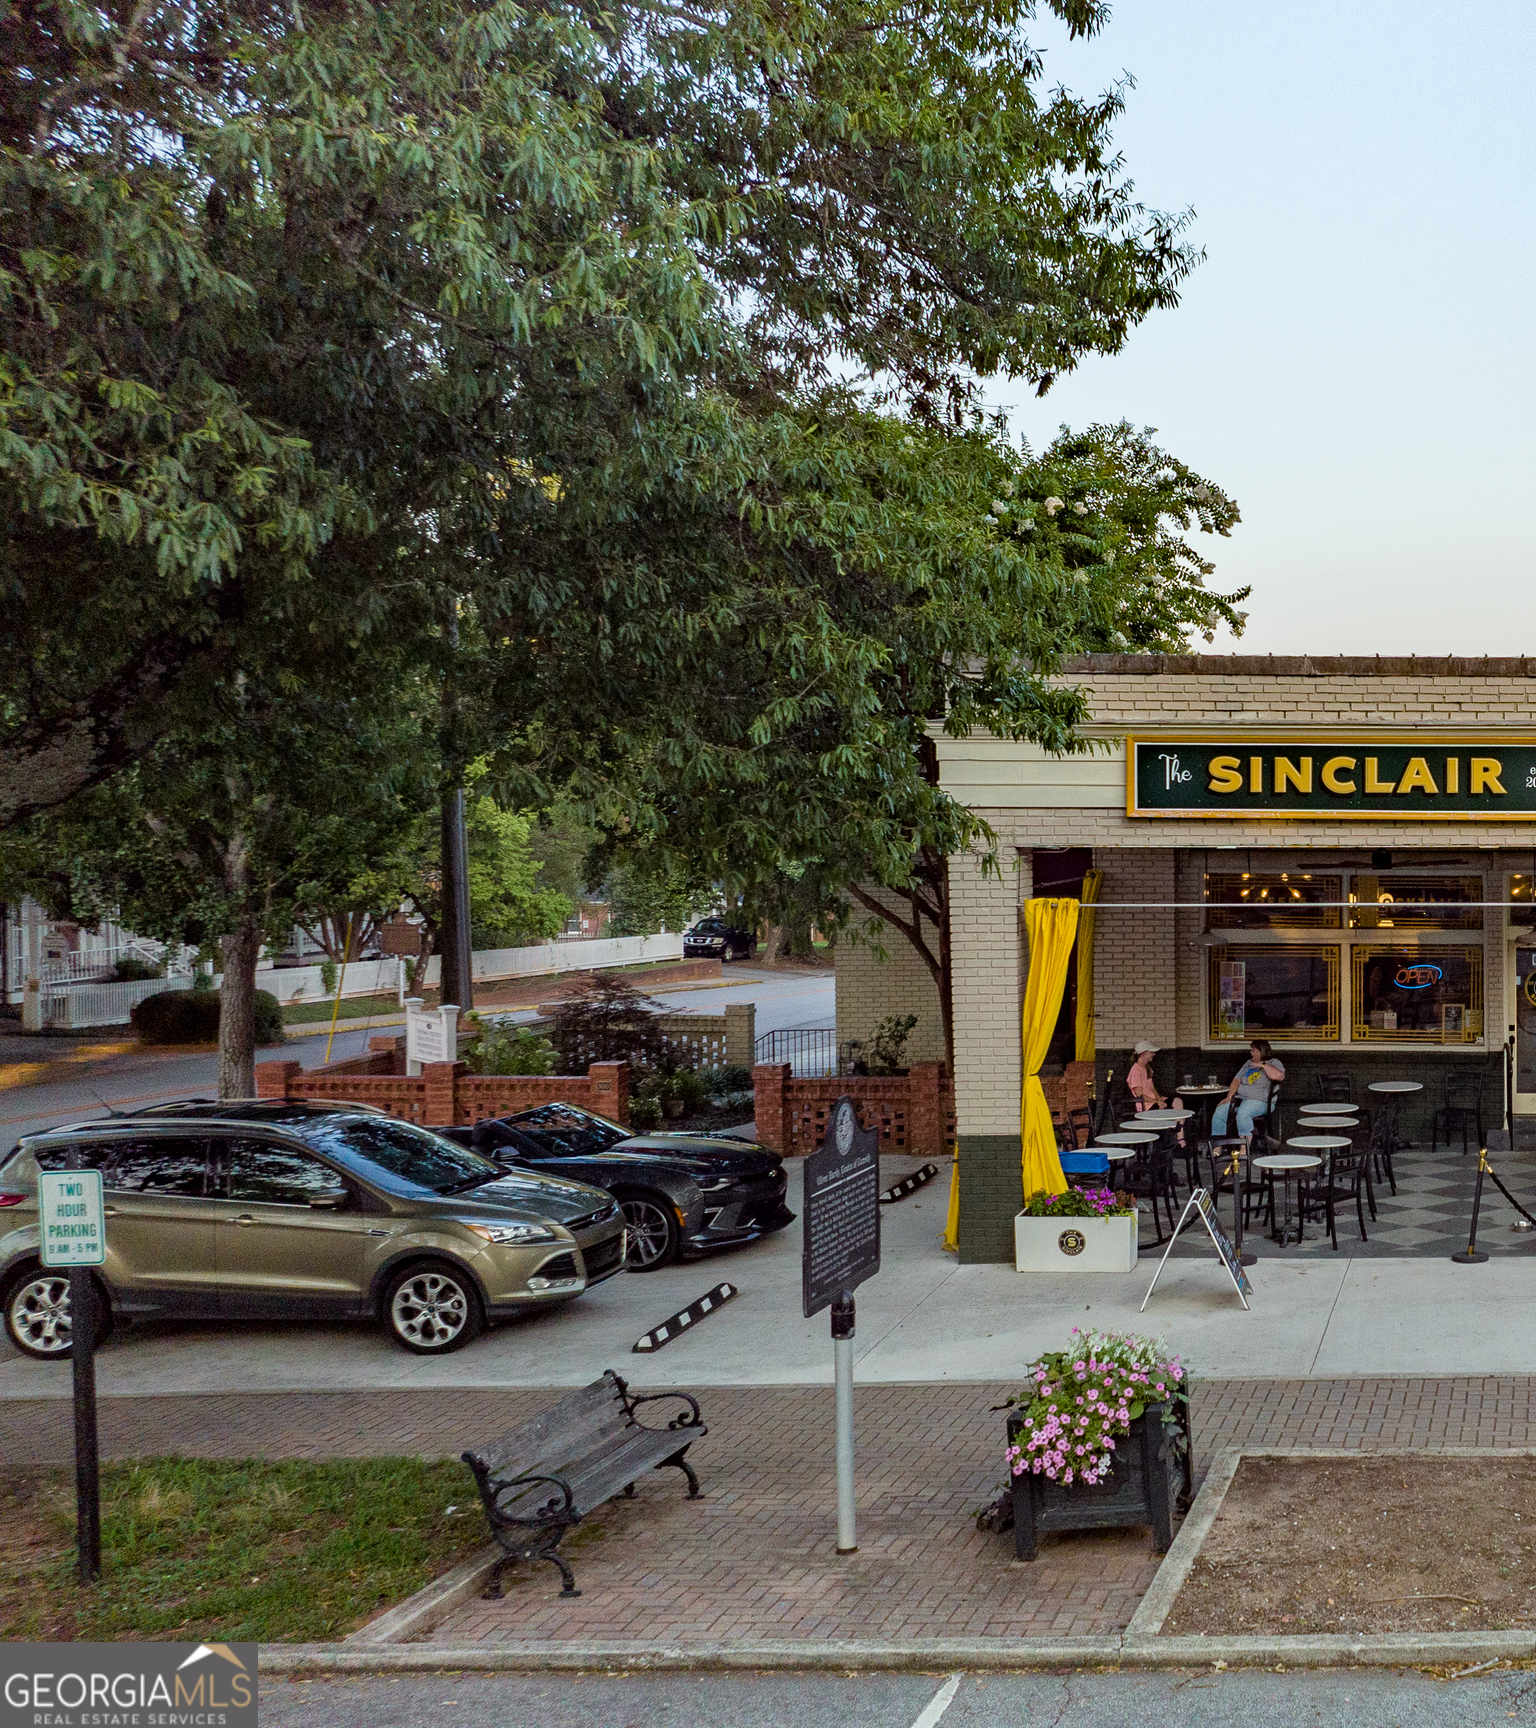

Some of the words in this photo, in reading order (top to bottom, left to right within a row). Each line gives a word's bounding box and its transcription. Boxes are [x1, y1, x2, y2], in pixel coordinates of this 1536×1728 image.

[1158, 754, 1192, 790] The
[1208, 756, 1508, 794] SINCLAIR
[1396, 969, 1438, 985] OPEN
[58, 1183, 83, 1196] TWO
[57, 1203, 87, 1217] HOUR
[49, 1223, 97, 1238] PARKING
[49, 1244, 55, 1254] 9
[57, 1244, 70, 1254] AM
[77, 1243, 83, 1253] 5
[85, 1243, 98, 1252] PM
[1067, 1237, 1077, 1248] S
